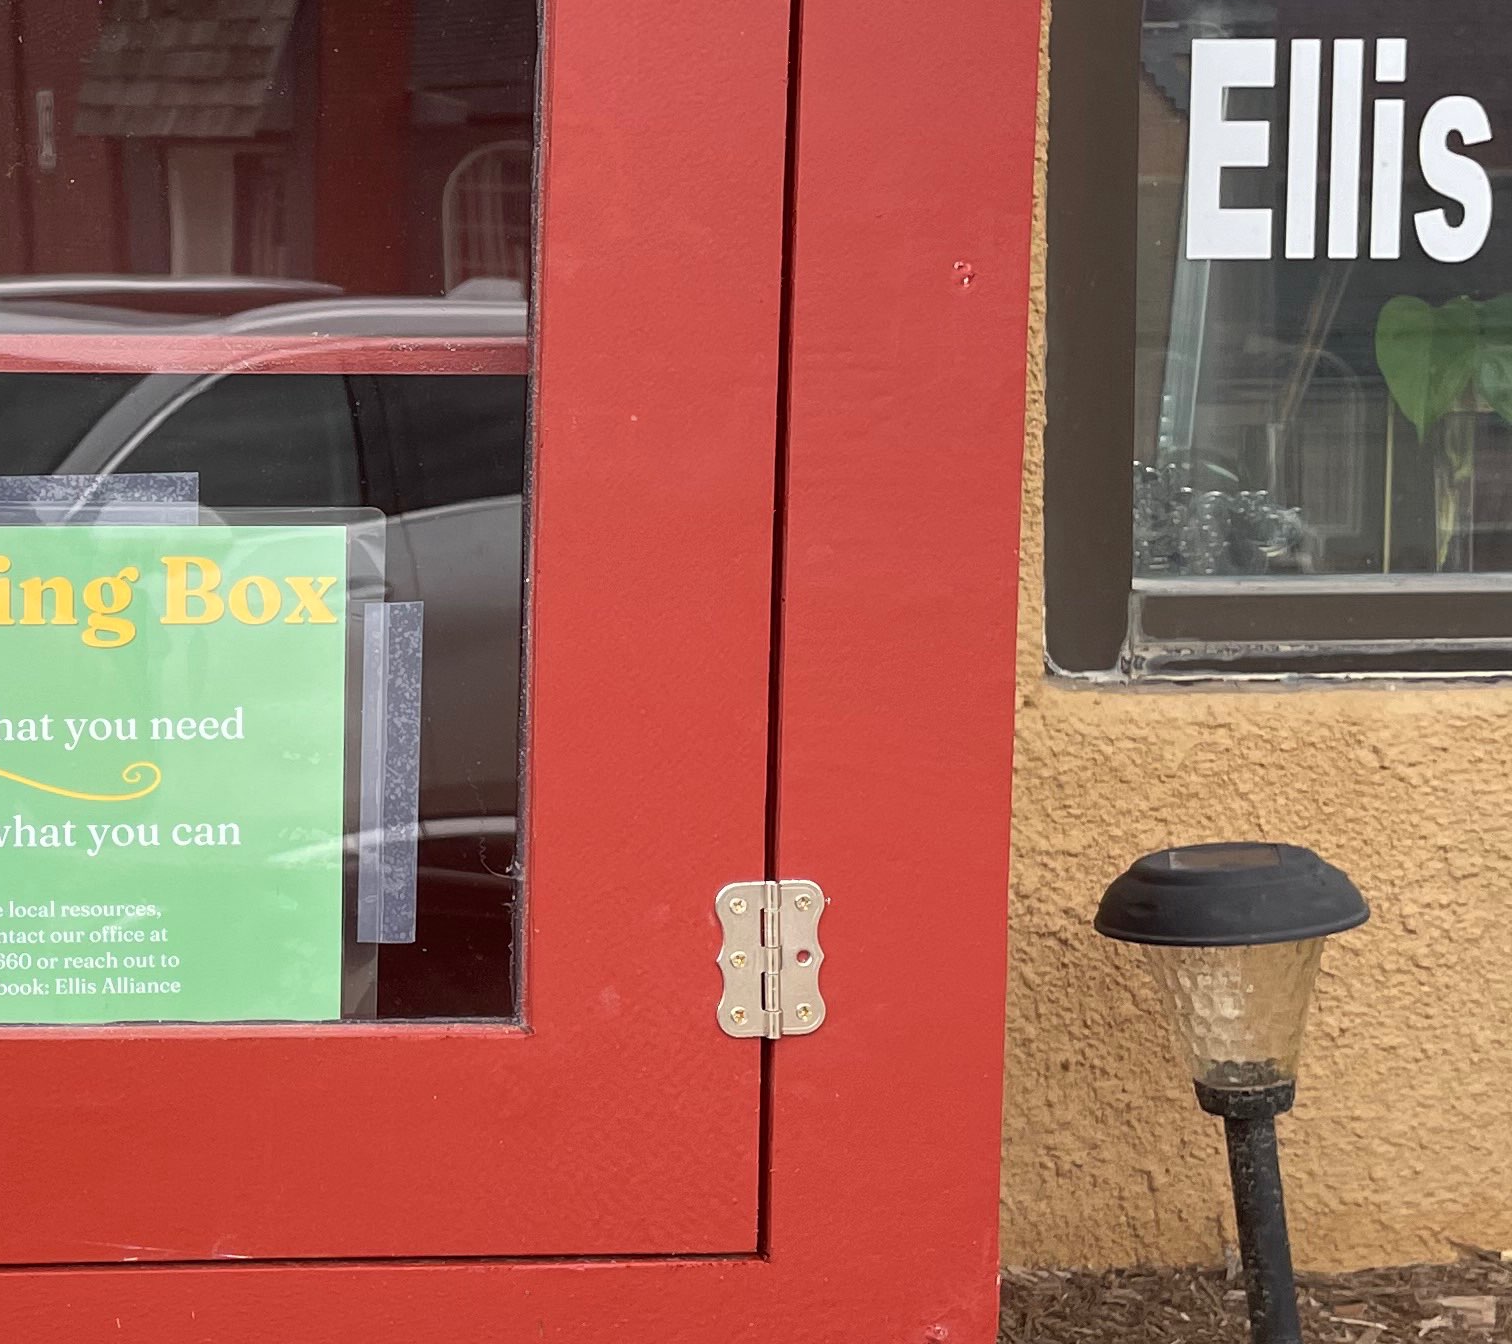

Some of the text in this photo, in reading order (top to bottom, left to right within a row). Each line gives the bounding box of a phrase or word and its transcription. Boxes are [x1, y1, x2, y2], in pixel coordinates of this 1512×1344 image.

[1186, 38, 1492, 262] Ellis
[159, 556, 339, 627] Box
[64, 718, 139, 752] you
[151, 707, 246, 741] need
[87, 824, 161, 858] you
[172, 823, 242, 848] can
[9, 901, 56, 918] local
[61, 903, 163, 922] resources,
[50, 930, 86, 945] our
[89, 926, 146, 943] office
[149, 927, 169, 943] at
[37, 956, 60, 971] or
[64, 952, 119, 970] reach
[123, 954, 156, 969] out
[160, 952, 181, 969] to
[55, 978, 98, 996] Ellis
[101, 977, 183, 995] Alliance
